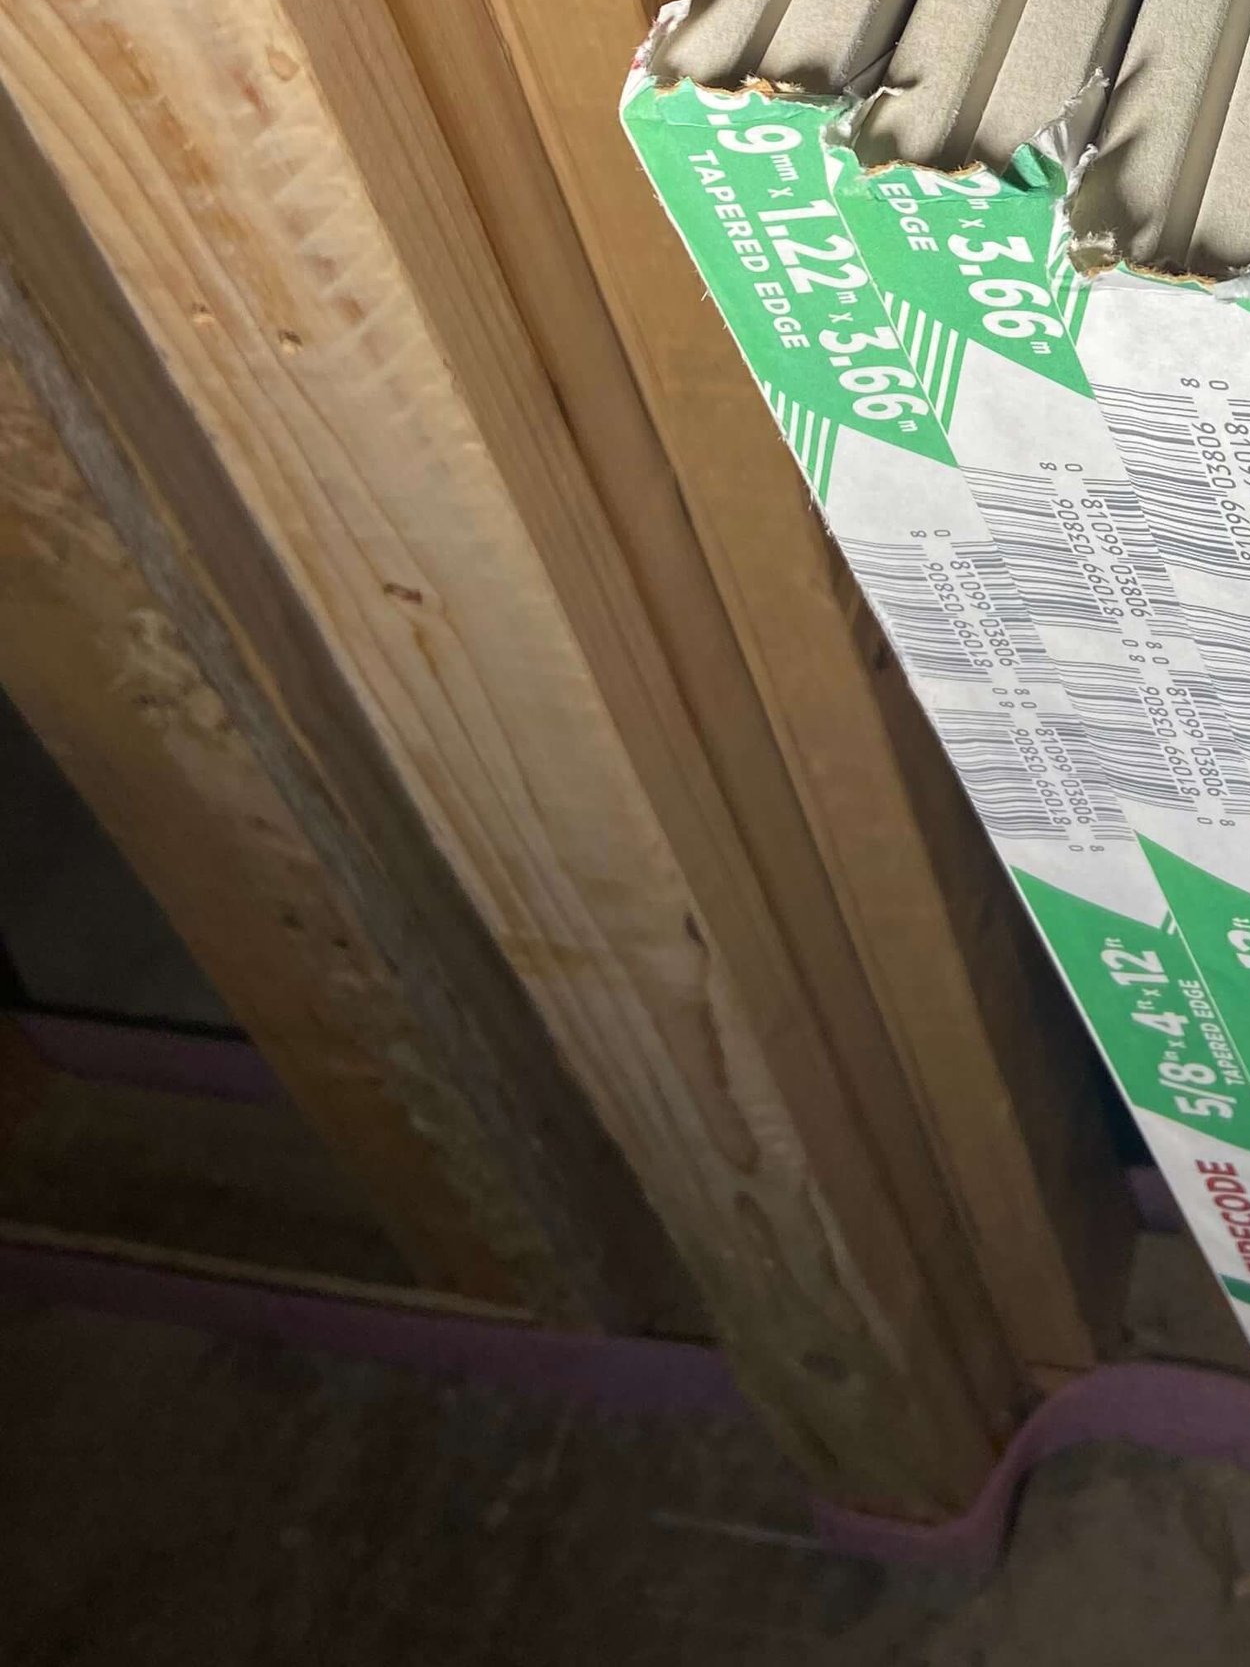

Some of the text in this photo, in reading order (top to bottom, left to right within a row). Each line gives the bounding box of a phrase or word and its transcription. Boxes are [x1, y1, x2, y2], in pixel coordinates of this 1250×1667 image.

[768, 187, 794, 198] x
[878, 184, 939, 251] EDGE
[959, 219, 985, 228] x
[688, 150, 811, 349] TAPERED EDGE
[757, 199, 869, 305] 1.22m
[948, 234, 1063, 354] 3.66m
[828, 313, 853, 323] x
[819, 326, 929, 432] 3.66m
[1192, 422, 1236, 488] 03806
[1052, 499, 1124, 617] 81099 03806
[1081, 498, 1153, 617] 81099 03806
[923, 562, 993, 667] 81099 03806
[950, 560, 1020, 666] 81099 03806
[1139, 687, 1200, 796] 81099 03806
[1166, 687, 1228, 796] 81099 03806
[1178, 979, 1245, 1085] TAPERED EDGE
